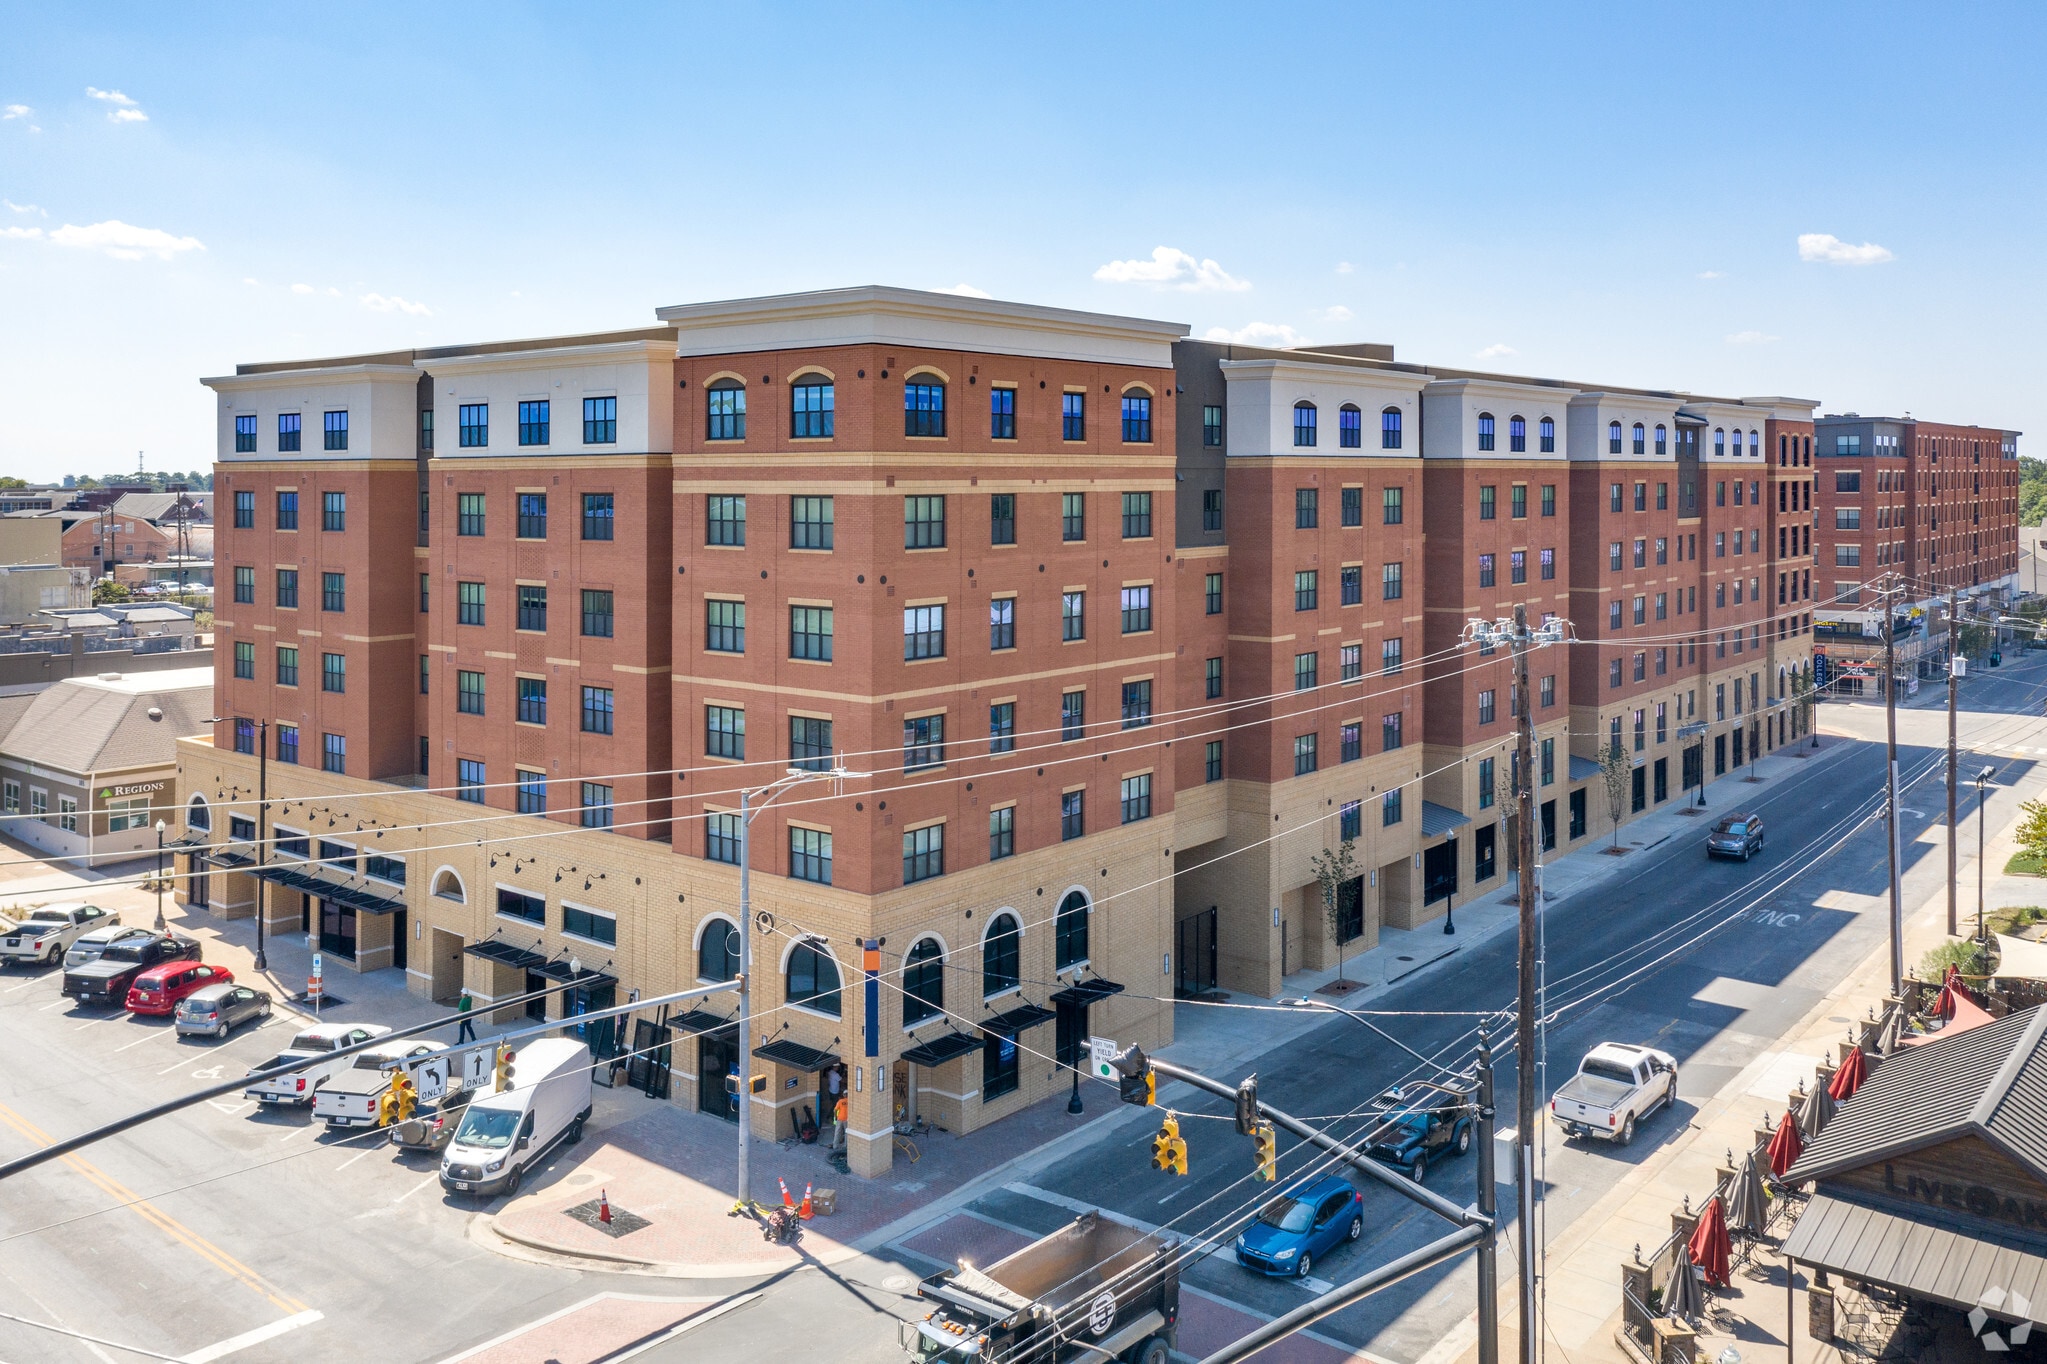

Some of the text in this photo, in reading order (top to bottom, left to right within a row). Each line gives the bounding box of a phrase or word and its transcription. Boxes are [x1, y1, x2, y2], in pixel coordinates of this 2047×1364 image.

[114, 781, 165, 796] REGIONS
[1096, 1047, 1112, 1057] YIELD
[466, 1075, 488, 1087] ONLY
[893, 1072, 907, 1083] SE
[421, 1086, 443, 1100] ONLY
